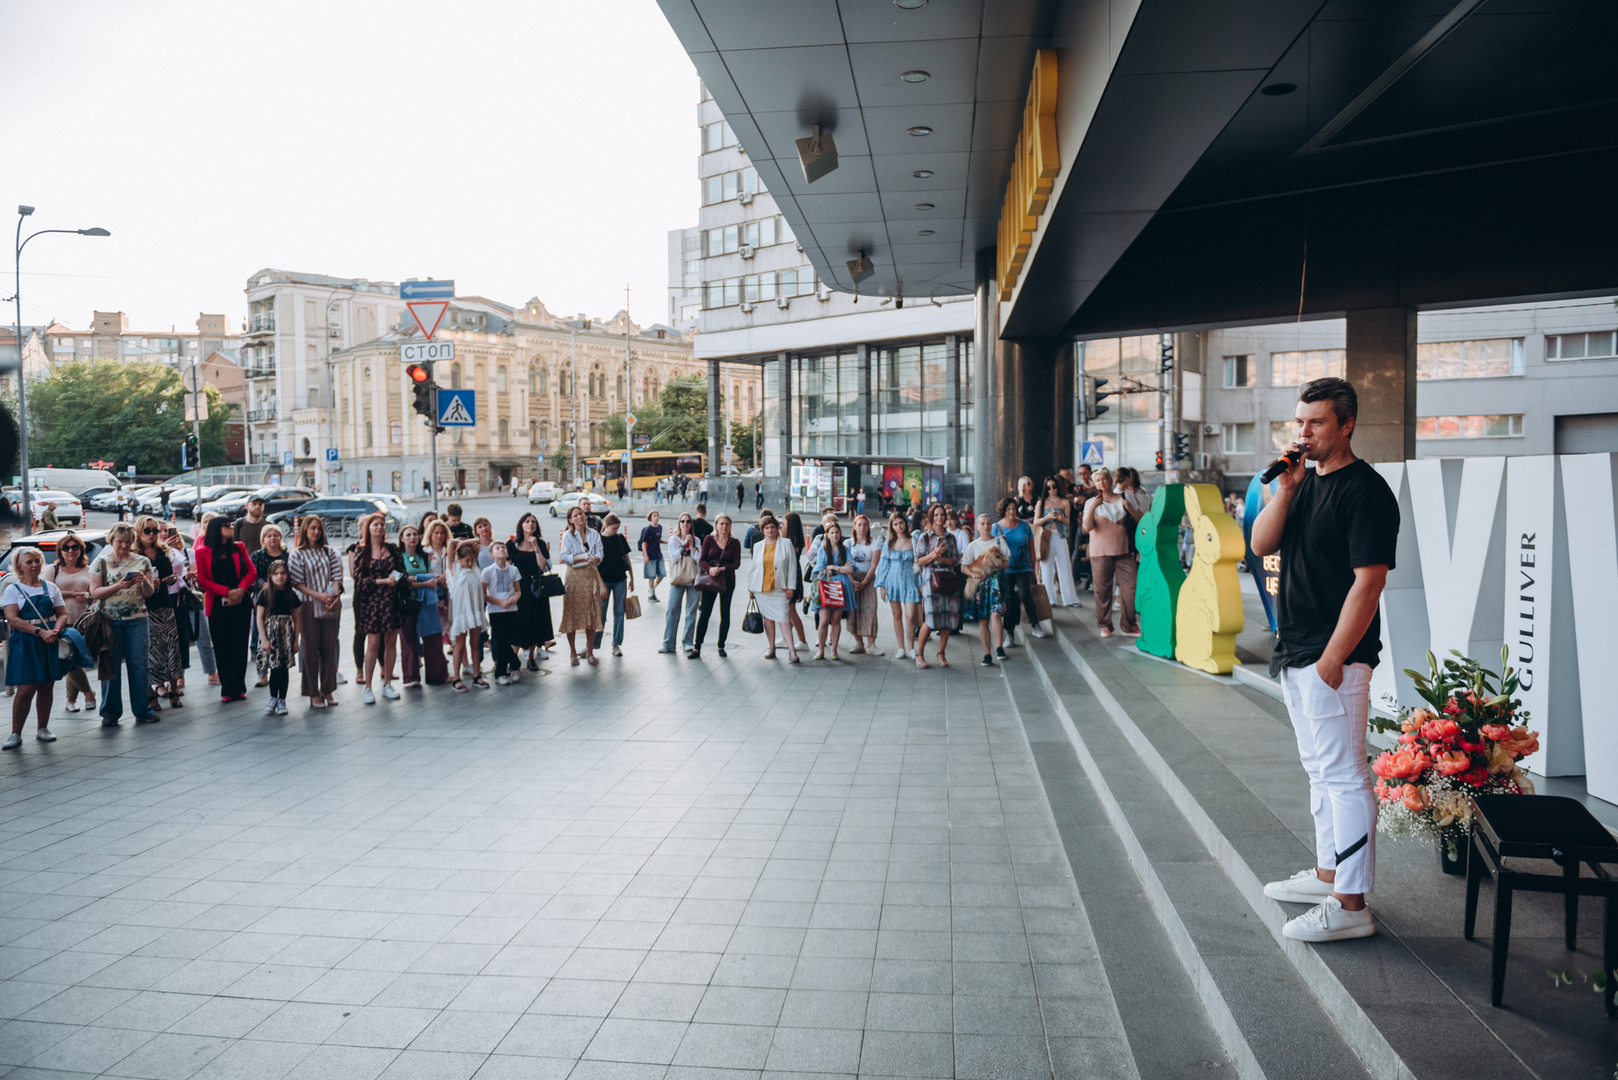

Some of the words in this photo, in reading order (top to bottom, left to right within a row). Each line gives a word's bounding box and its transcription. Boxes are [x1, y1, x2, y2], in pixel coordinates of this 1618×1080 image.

[404, 344, 451, 360] СТОП
[328, 449, 337, 461] P
[1517, 531, 1537, 692] GULLIVER
